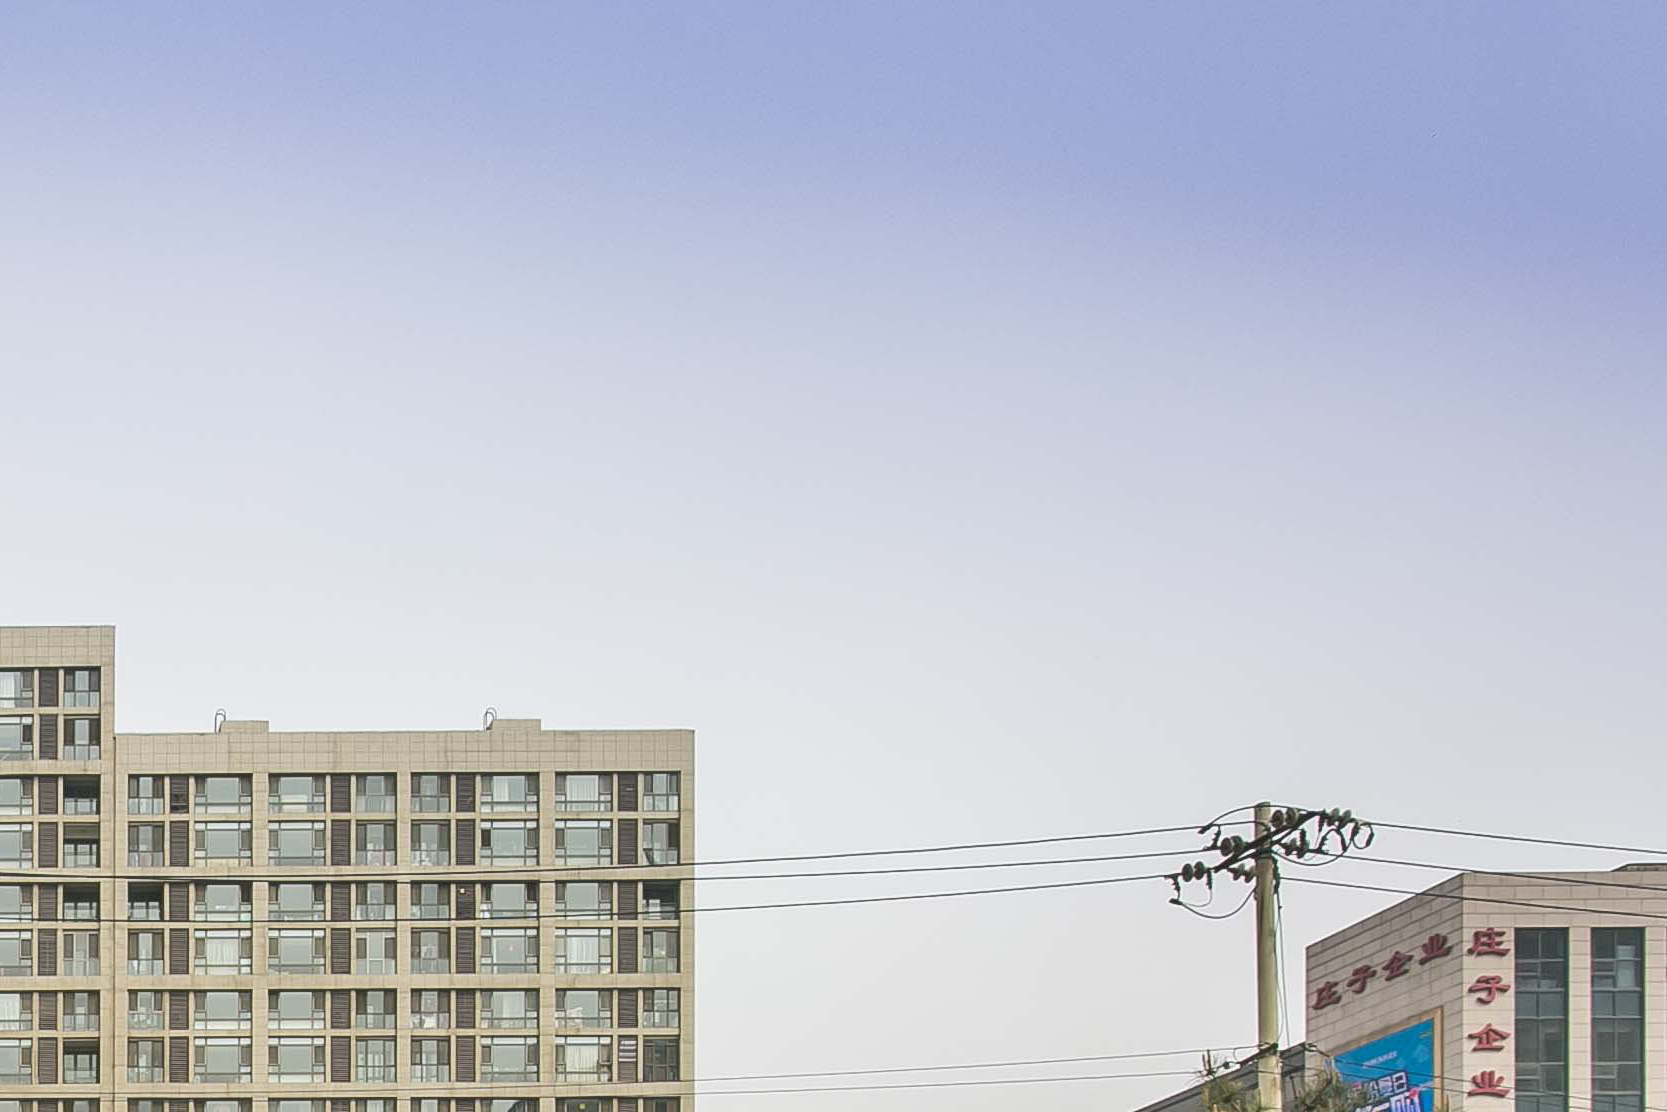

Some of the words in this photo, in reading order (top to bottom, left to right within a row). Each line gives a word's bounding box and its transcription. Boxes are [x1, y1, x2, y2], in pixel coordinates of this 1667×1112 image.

[1311, 932, 1453, 1010] 庄子企业
[1467, 926, 1512, 1099] 庄子企业
